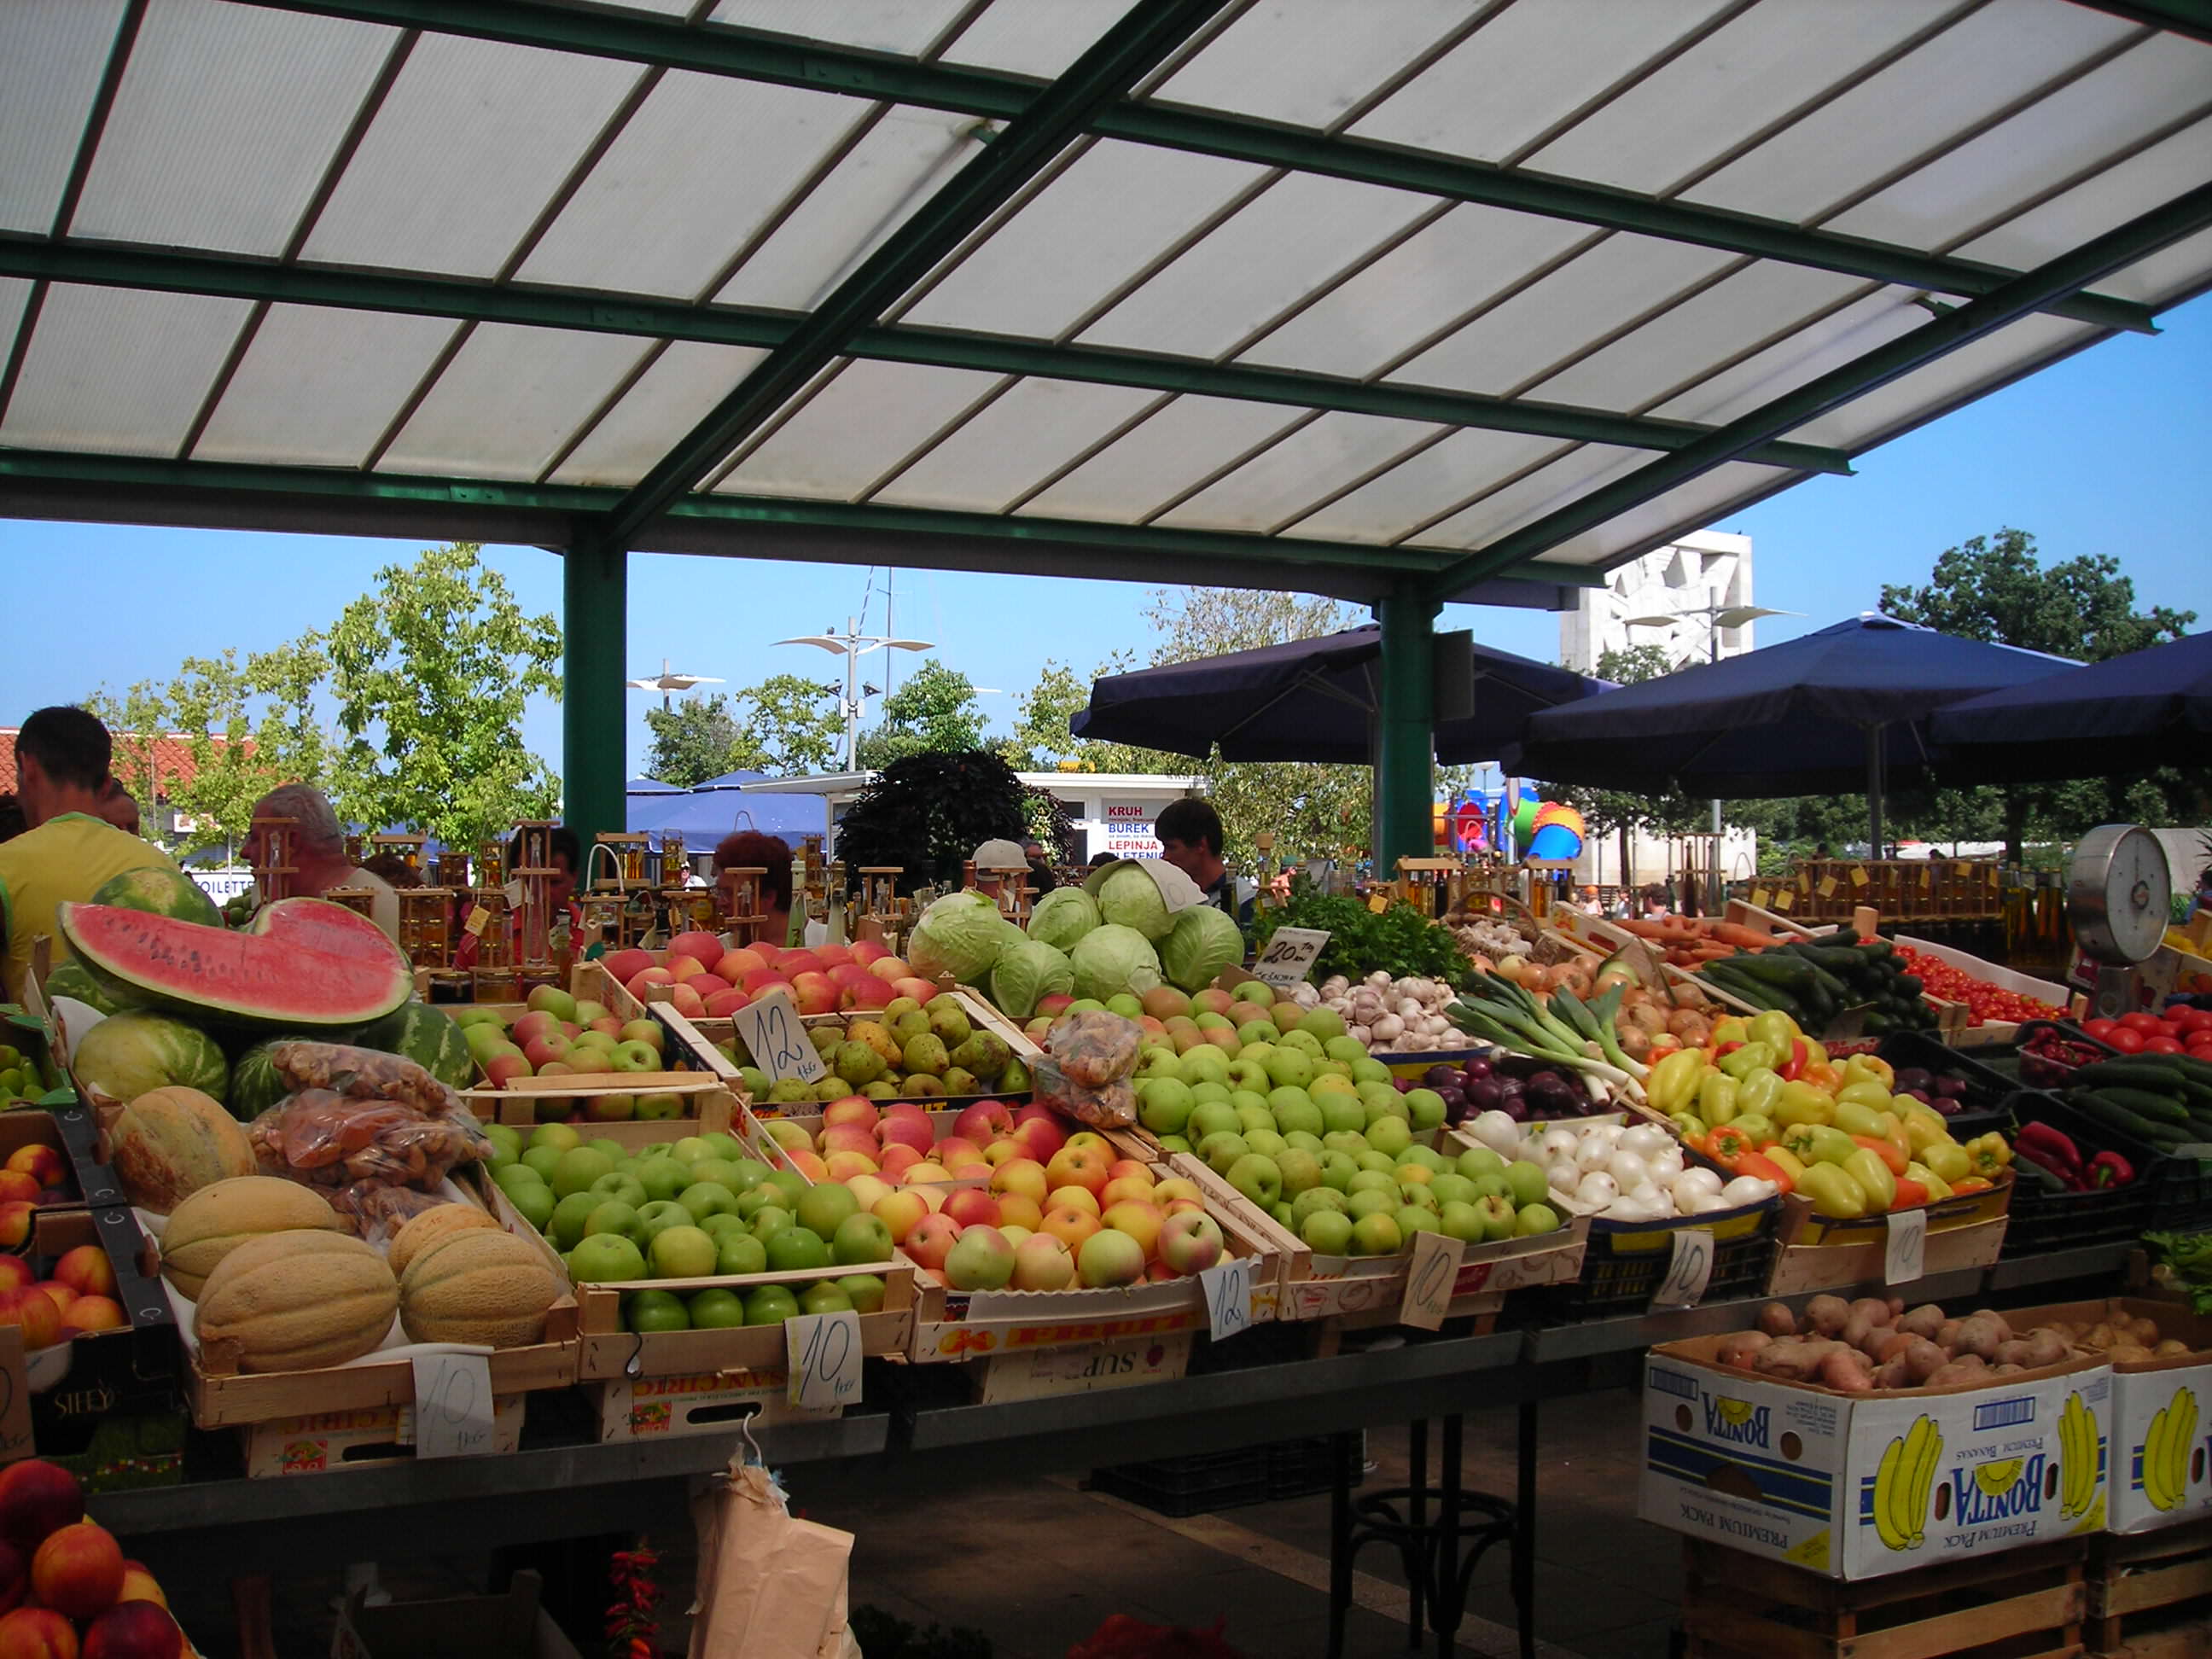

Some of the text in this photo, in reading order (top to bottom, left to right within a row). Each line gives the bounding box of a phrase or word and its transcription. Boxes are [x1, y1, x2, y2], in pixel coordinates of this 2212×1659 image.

[1109, 806, 1143, 816] KRUH
[1109, 824, 1149, 833] BUREK
[1109, 841, 1158, 850] LEPINJA
[196, 882, 254, 894] OILETT
[1263, 941, 1296, 963] 20
[756, 1005, 804, 1081] 12
[1408, 1243, 1451, 1310] 10
[1662, 1236, 1705, 1295] 10
[1215, 1270, 1241, 1336] 12
[800, 1316, 850, 1402] 10
[424, 1359, 475, 1451] 10
[1702, 1392, 1770, 1448] BONITA
[1955, 1437, 2043, 1461] PREMIUM BANANAS
[1951, 1453, 2046, 1527] BONITA
[1679, 1504, 1714, 1527] PACK
[1719, 1516, 1789, 1549] PREMIUM
[1944, 1521, 2037, 1549] PREMIUM PACK
